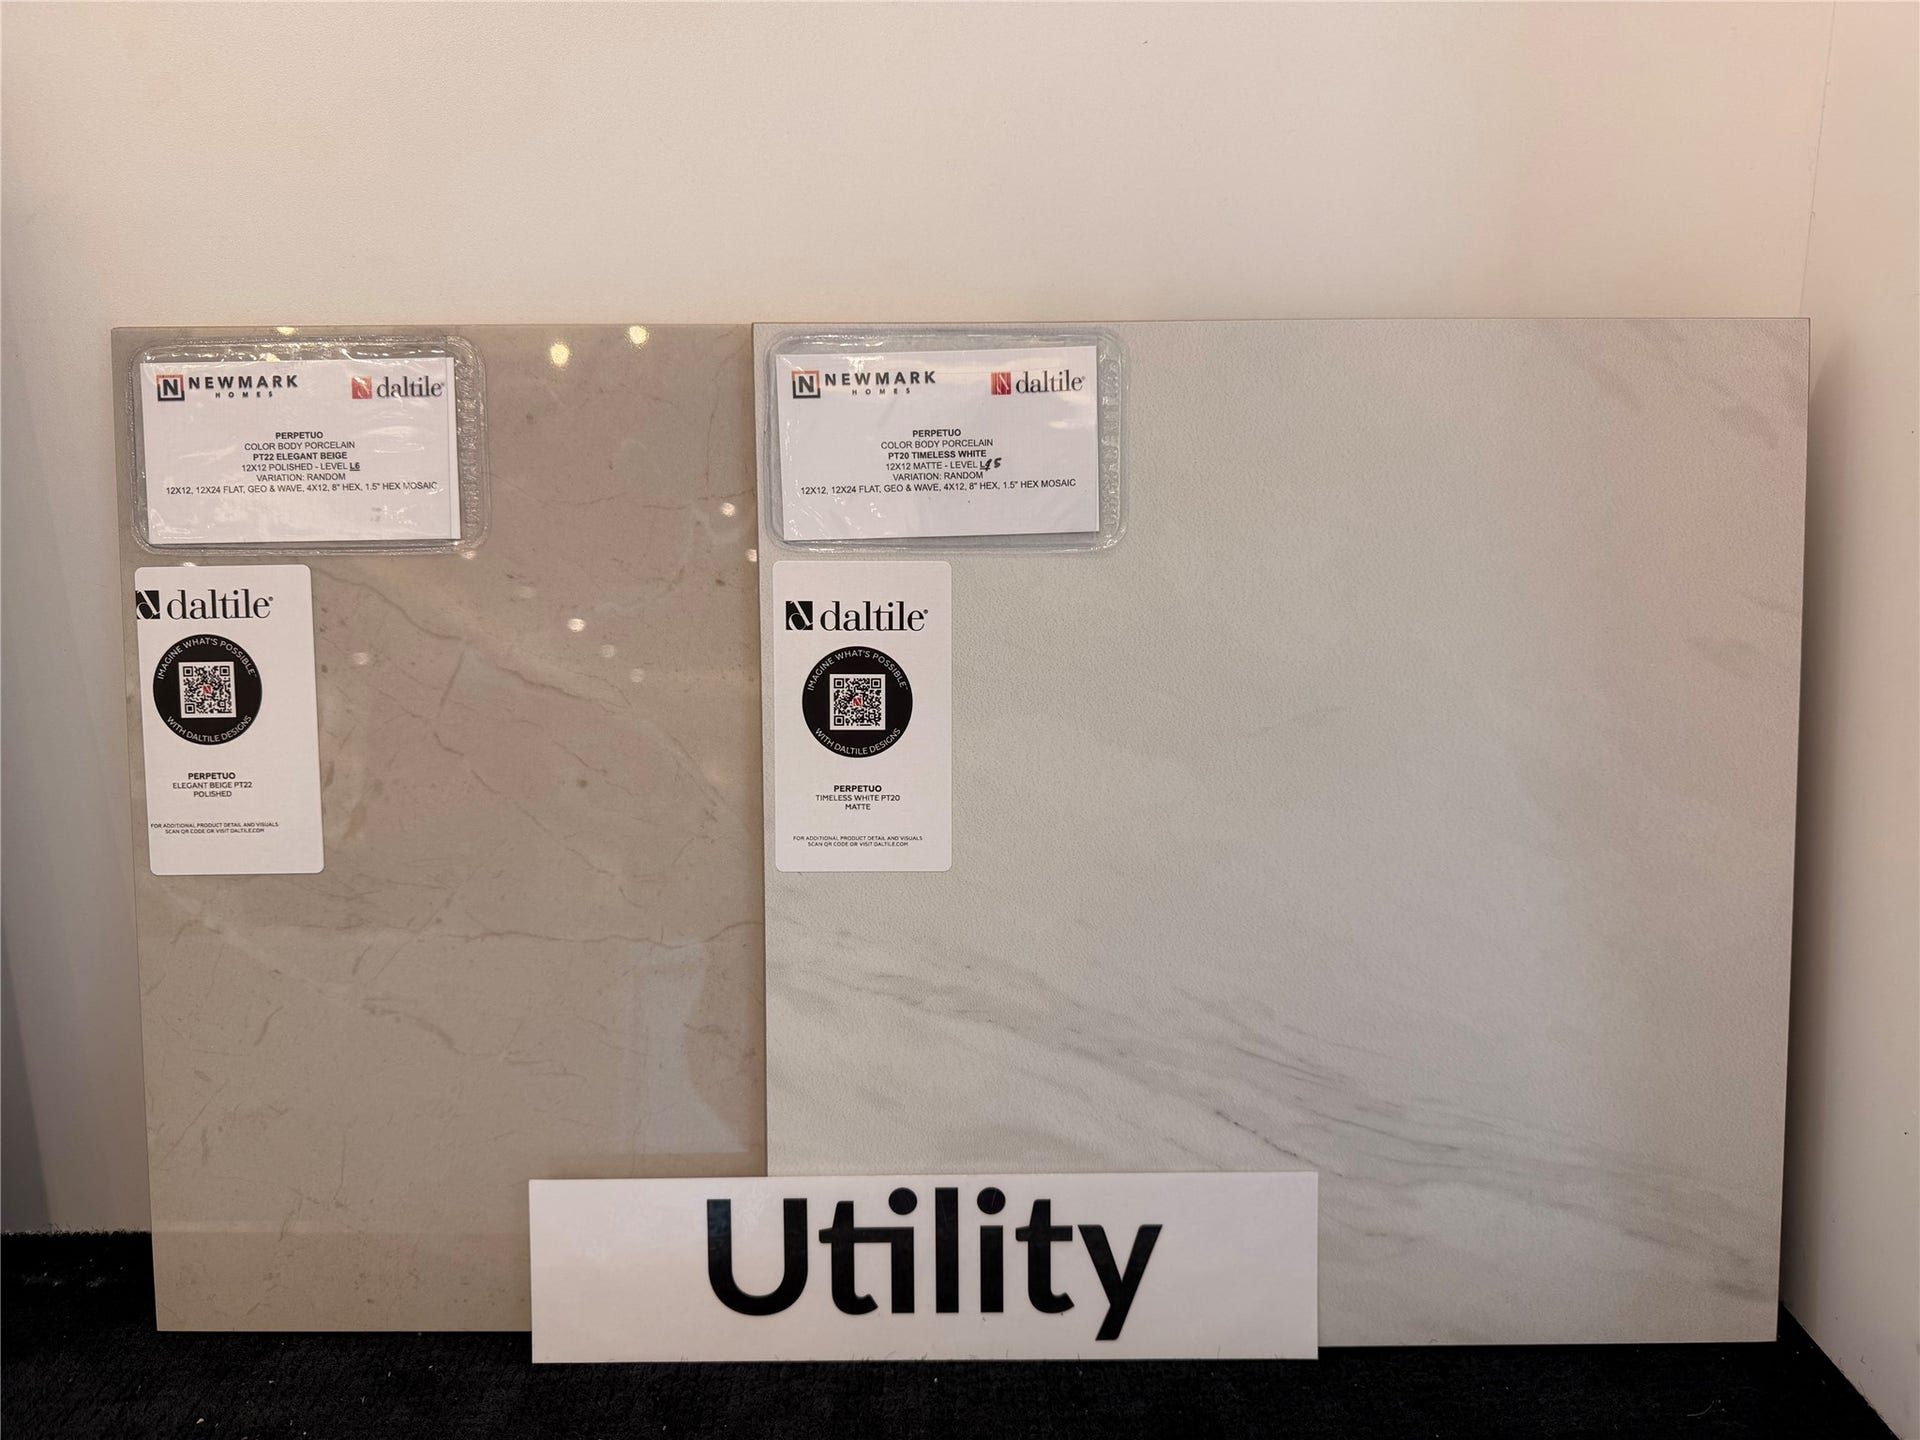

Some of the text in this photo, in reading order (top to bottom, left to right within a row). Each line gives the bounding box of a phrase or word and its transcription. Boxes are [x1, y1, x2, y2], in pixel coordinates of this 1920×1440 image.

[188, 375, 298, 389] NEWMARK
[824, 371, 936, 386] NEWMARK
[1016, 370, 1083, 393] daltile
[377, 376, 443, 398] daltile
[275, 431, 323, 440] PERPETUO
[912, 429, 961, 437] PERPETUO
[244, 441, 355, 450] COLOR BODY PORCELAIN
[881, 439, 993, 449] COLOR BODY PORCELAIN
[277, 452, 317, 460] ELEGANT
[321, 452, 347, 460] BEIGE
[888, 450, 987, 459] PT20 TIMELESS WHITE
[242, 464, 266, 472] 12X12
[269, 463, 313, 471] POLISHED
[321, 462, 347, 471] LEVEL
[350, 462, 360, 470] L6
[886, 462, 911, 470] 12X12
[913, 462, 942, 470] MATTE
[950, 461, 977, 469] LEVEL
[257, 473, 346, 481] VARIATION: RANDOM
[892, 471, 983, 481] VARIATION: RANDOM
[166, 486, 194, 496] 12X12,
[196, 486, 221, 495] 12X24
[223, 485, 246, 494] FLAT,
[248, 485, 267, 494] GEO
[270, 485, 275, 493] &
[278, 484, 304, 493] WAVE,
[307, 484, 330, 493] 4X12,
[332, 483, 340, 492] 8"
[342, 483, 363, 492] HEX,
[365, 483, 380, 492] 1.5"
[383, 482, 400, 491] HEX
[801, 479, 1076, 495] 12X12, 12X24 FLAT, GEO & WAVE, 4X12, 8" HEX, 1.5" HEX MOSAIC
[167, 589, 270, 620] daltile
[820, 601, 925, 631] daltile
[158, 638, 255, 680] IMAGINE WHAT'S POSSIBLE
[807, 650, 907, 691] IMAGINE WHAT'S POSSIBLE
[166, 714, 252, 742] WITH DALTILE DESIGNS
[815, 728, 901, 755] WITH DALTILE DESIGNS
[188, 772, 236, 780] PERPETUO
[194, 790, 232, 798] POLISHED
[834, 785, 882, 793] PERPETUO
[706, 1186, 1164, 1342] Utility
